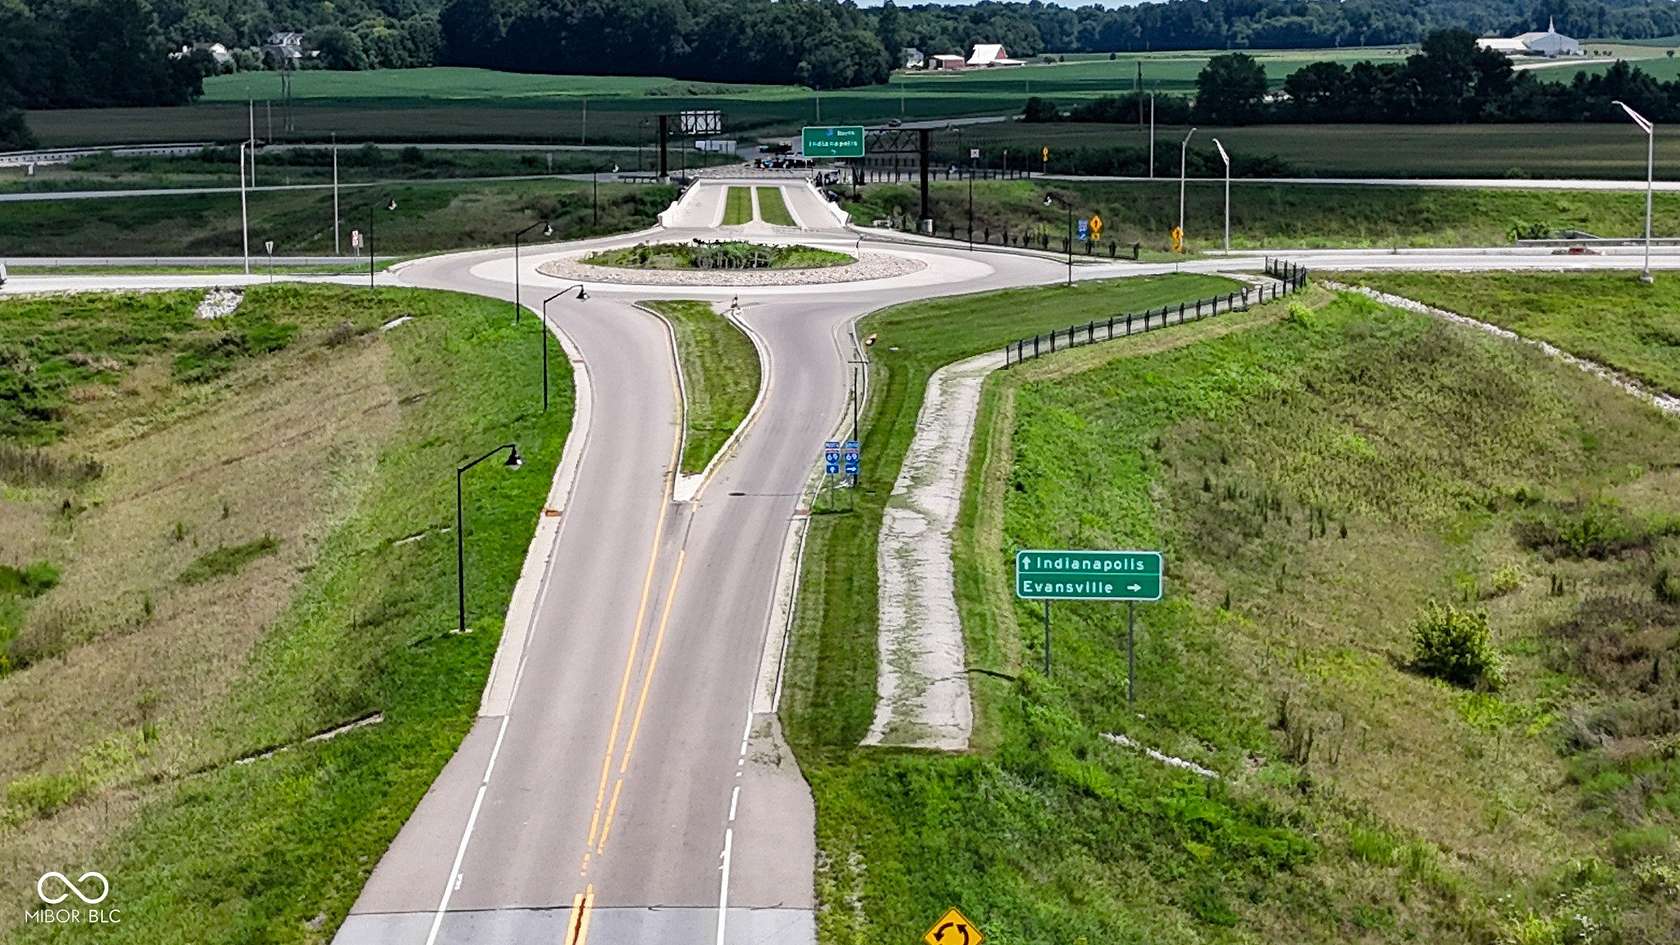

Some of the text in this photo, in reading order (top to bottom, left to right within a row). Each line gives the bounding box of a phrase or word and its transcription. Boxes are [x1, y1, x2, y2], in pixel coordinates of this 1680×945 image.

[827, 453, 838, 461] 69
[846, 453, 857, 461] 69
[1036, 556, 1145, 572] Indianapolis
[1022, 580, 1113, 594] Evansville
